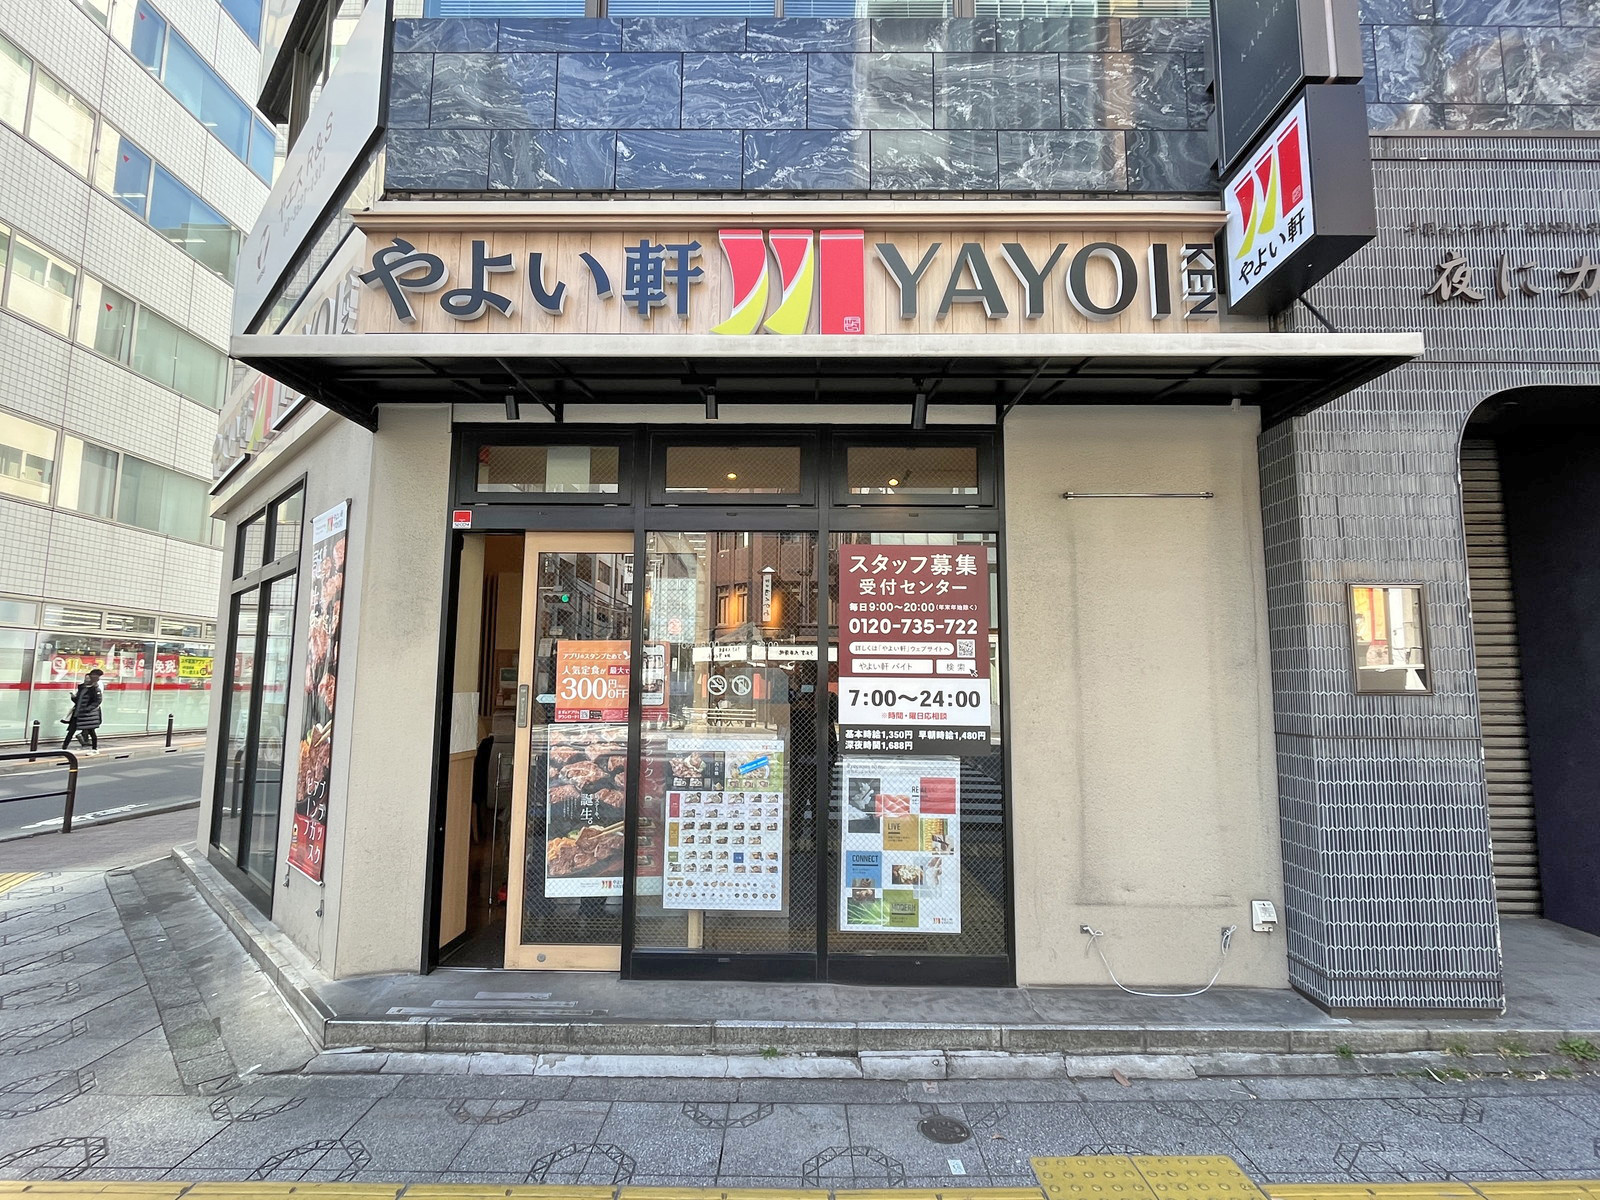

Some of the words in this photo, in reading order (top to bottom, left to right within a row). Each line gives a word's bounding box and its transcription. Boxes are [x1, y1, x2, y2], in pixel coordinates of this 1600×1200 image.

[1239, 207, 1305, 286] やよい軒
[358, 237, 705, 323] やよい軒
[874, 242, 1171, 319] YAYOI
[1182, 243, 1218, 319] KEN
[848, 553, 978, 576] スタッフ募集
[859, 578, 968, 596] 受付センター
[848, 618, 978, 635] 0120-735-722
[858, 662, 889, 671] やよい軒
[892, 662, 913, 671] バイト
[946, 663, 966, 672] 検索
[607, 689, 629, 699] OFF
[845, 729, 913, 740] 基本時給1,350円
[918, 730, 986, 741] 早朝時給1,480円
[887, 823, 901, 831] LIVE
[852, 854, 879, 863] CONNECT
